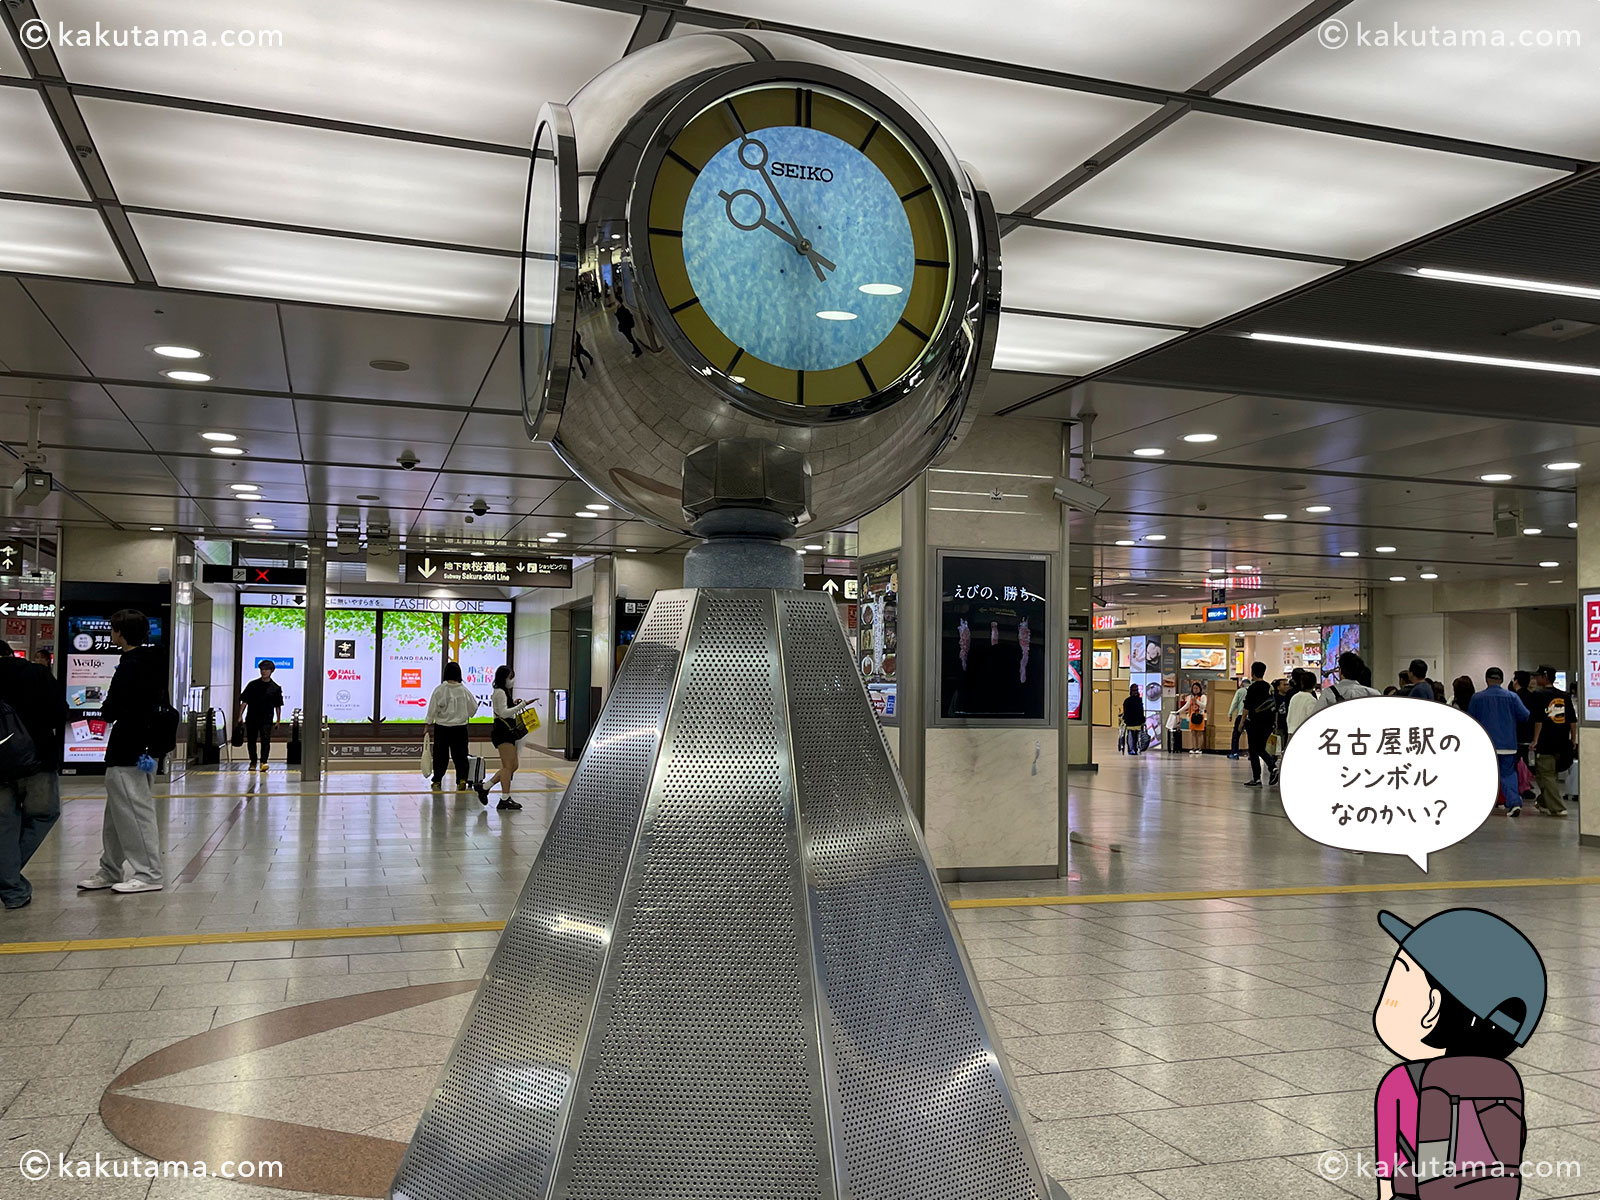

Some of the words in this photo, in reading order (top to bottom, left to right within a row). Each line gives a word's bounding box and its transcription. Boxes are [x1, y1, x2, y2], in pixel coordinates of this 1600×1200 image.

[771, 161, 834, 183] SEIKO
[444, 561, 507, 573] 地下鉄桜通線
[443, 572, 461, 580] Subway
[496, 573, 510, 581] Line
[270, 594, 284, 605] B1
[954, 585, 1036, 602] えびの、勝ち。
[393, 598, 451, 610] FASHION
[454, 599, 485, 612] ONE
[1238, 603, 1263, 619] Gift
[72, 659, 104, 668] Wedge
